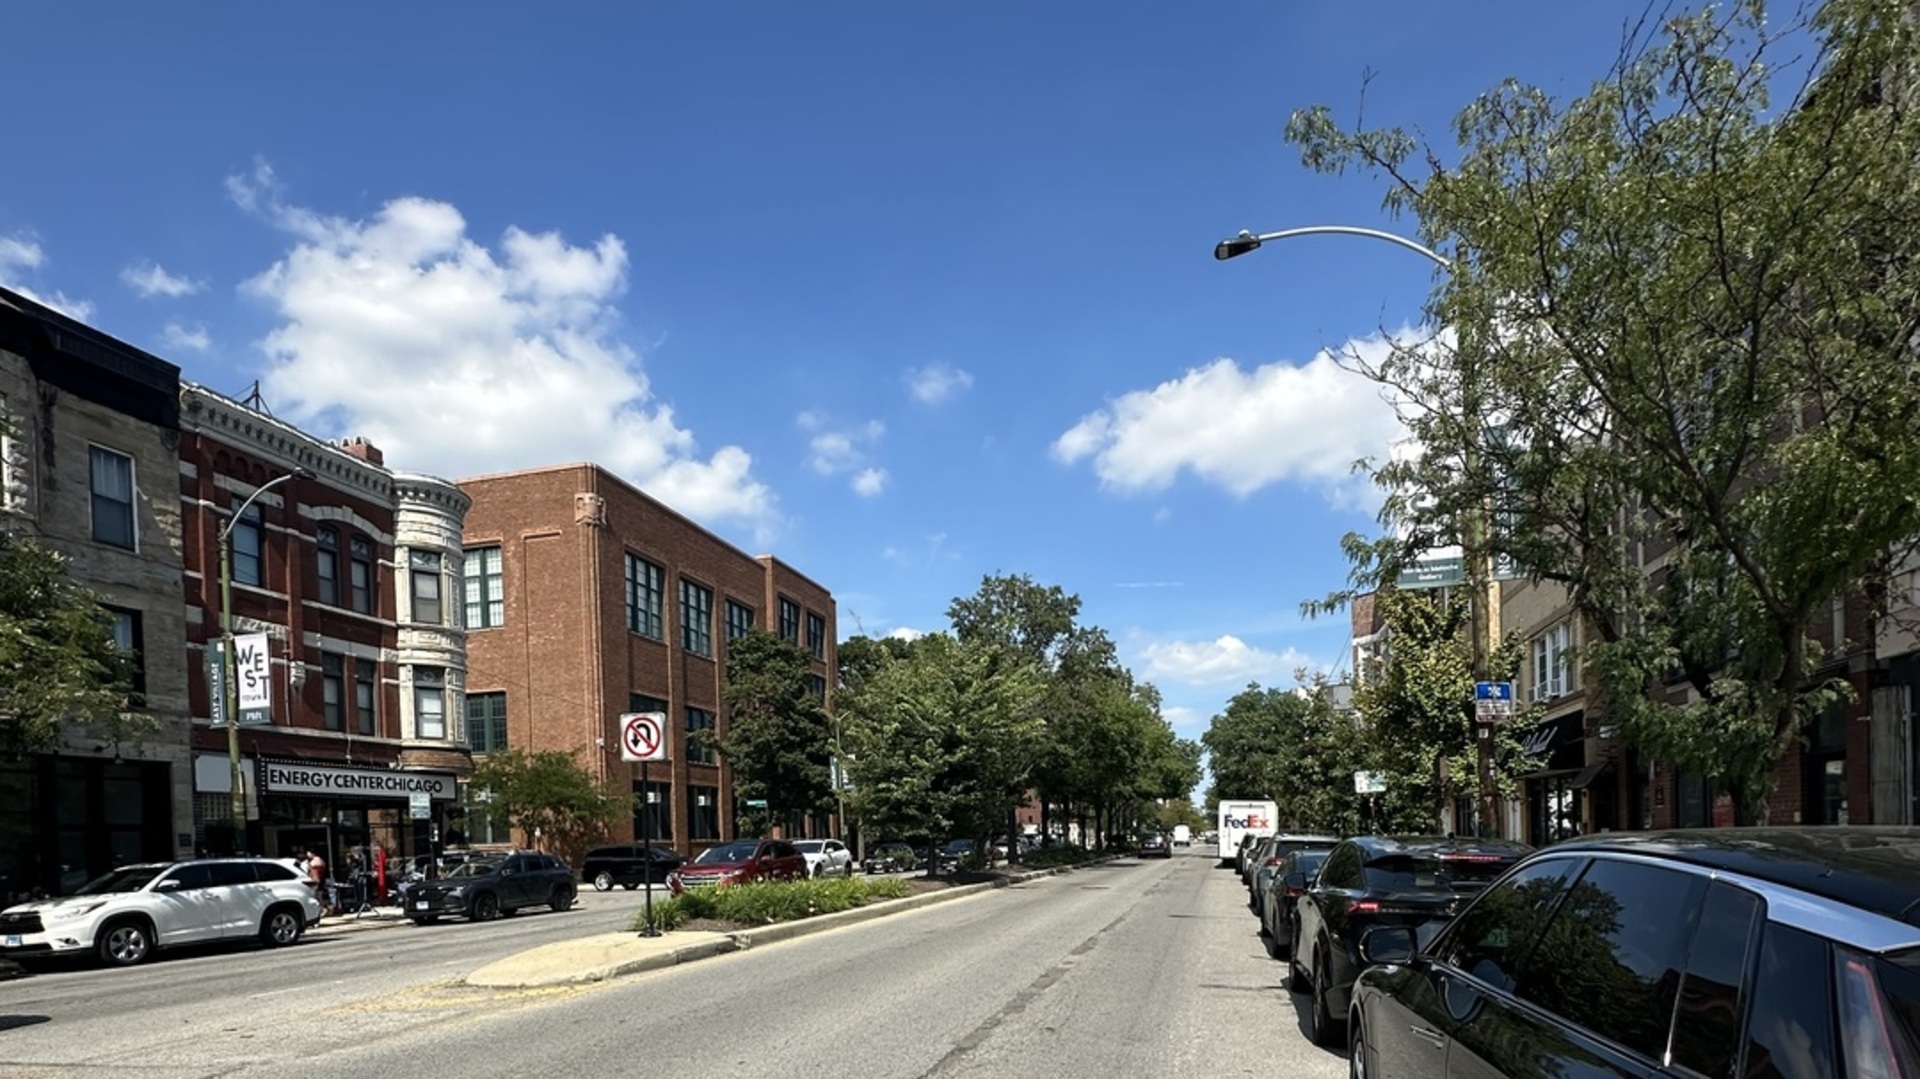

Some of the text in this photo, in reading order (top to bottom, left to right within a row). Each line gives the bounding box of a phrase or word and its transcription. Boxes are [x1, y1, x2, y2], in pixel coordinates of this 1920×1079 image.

[212, 701, 220, 725] EAST
[269, 768, 443, 794] ENERGY CENTER CHICAGO
[1224, 814, 1269, 829] FedEx
